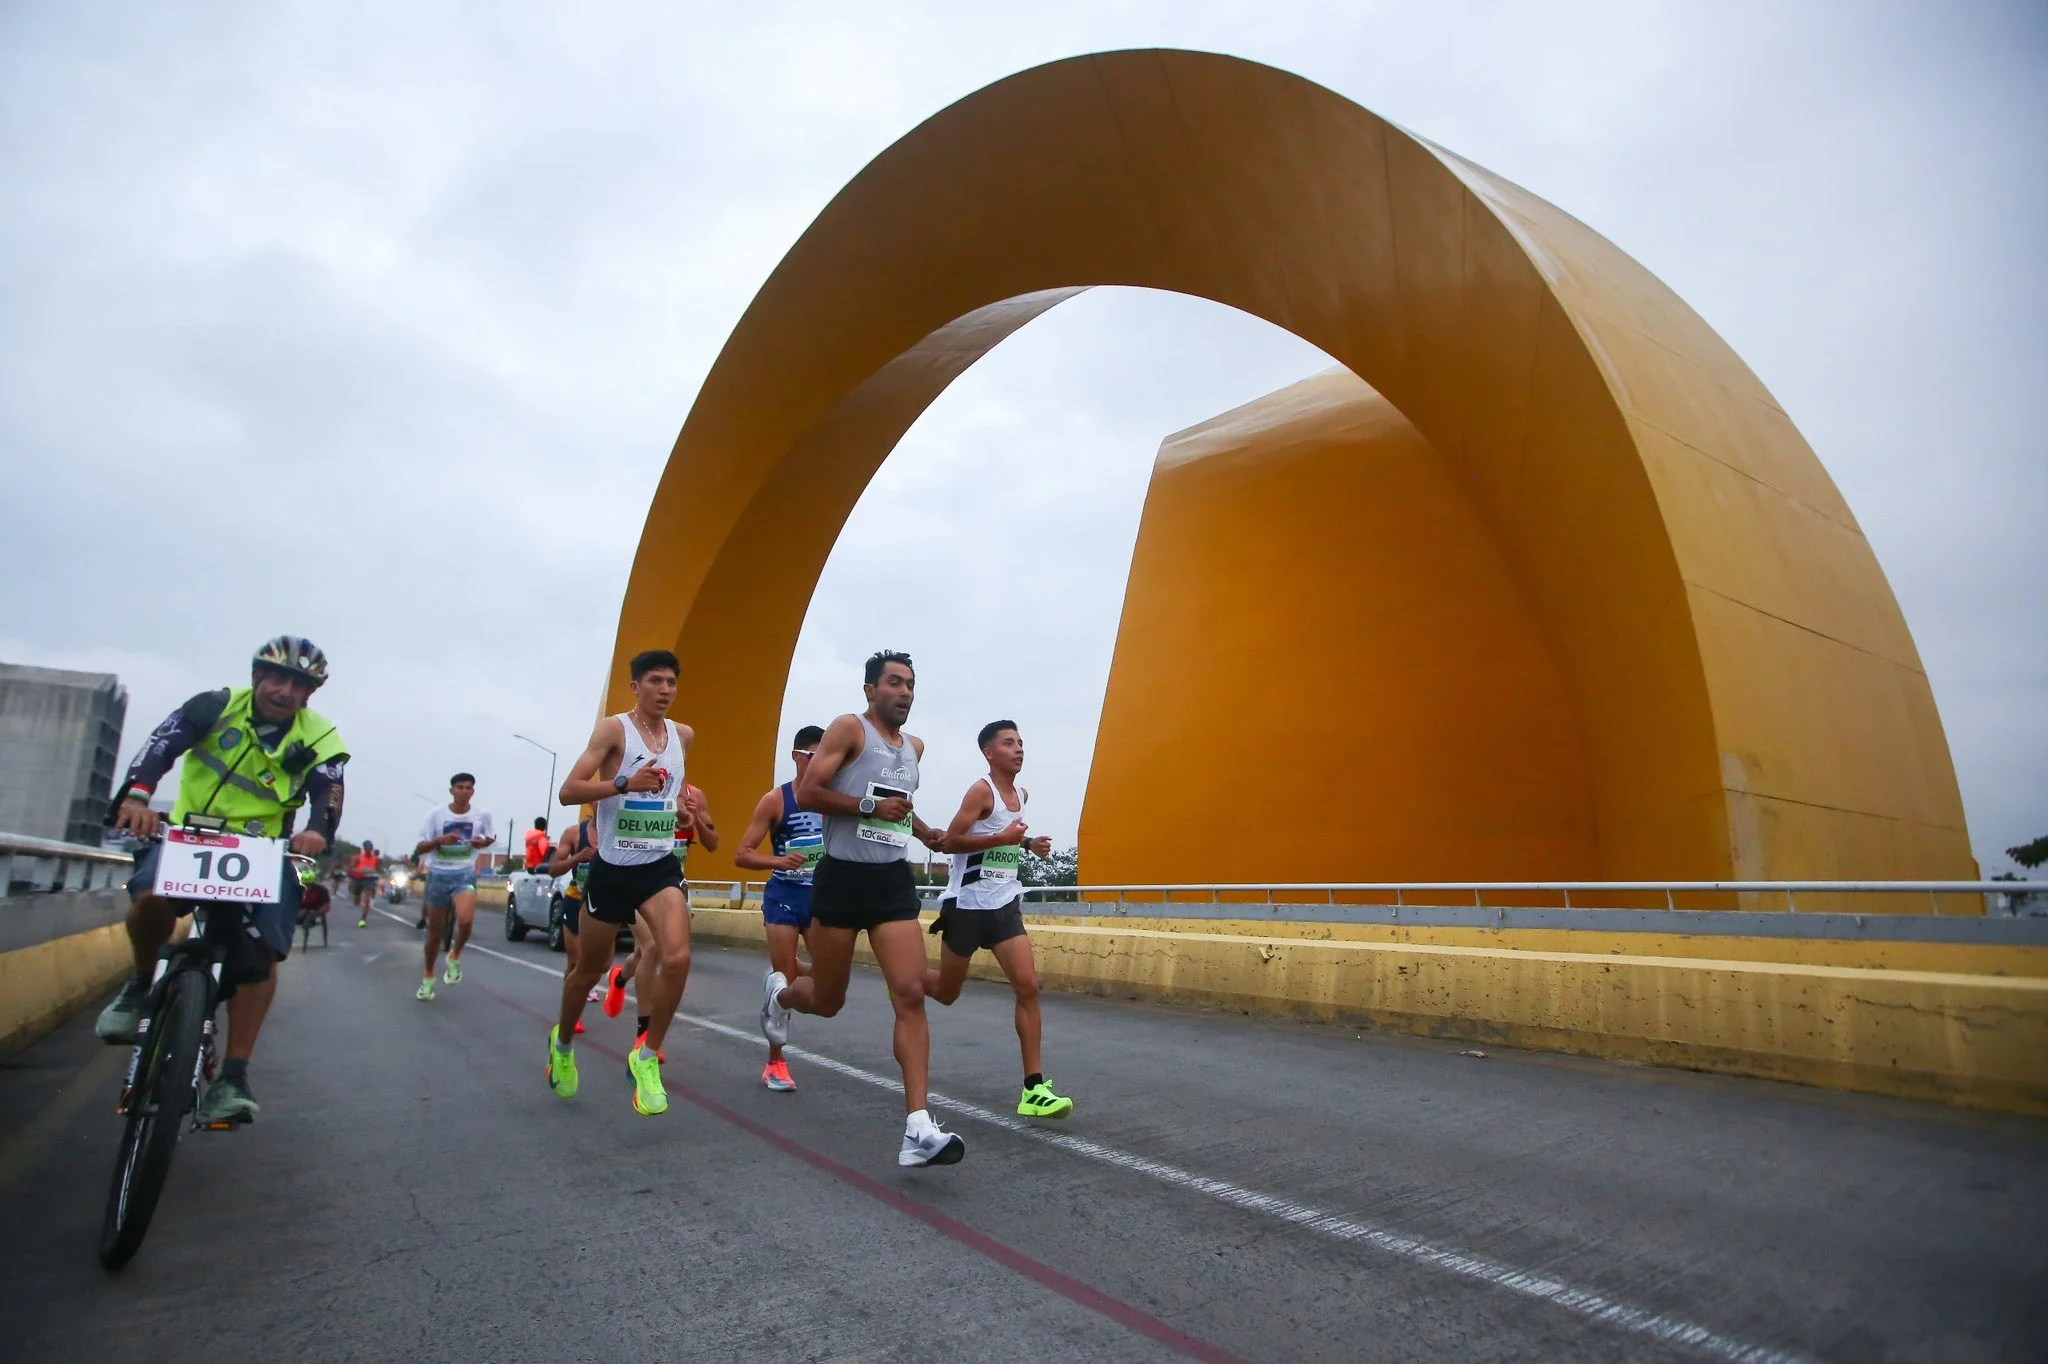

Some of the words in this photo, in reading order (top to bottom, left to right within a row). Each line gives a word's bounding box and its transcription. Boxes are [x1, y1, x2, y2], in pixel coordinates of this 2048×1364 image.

[873, 747, 897, 759] GARMIN
[618, 819, 642, 832] DEL
[617, 840, 633, 849] 10K
[193, 851, 250, 882] 10
[163, 881, 198, 893] BICI
[203, 884, 272, 898] OFICIAL
